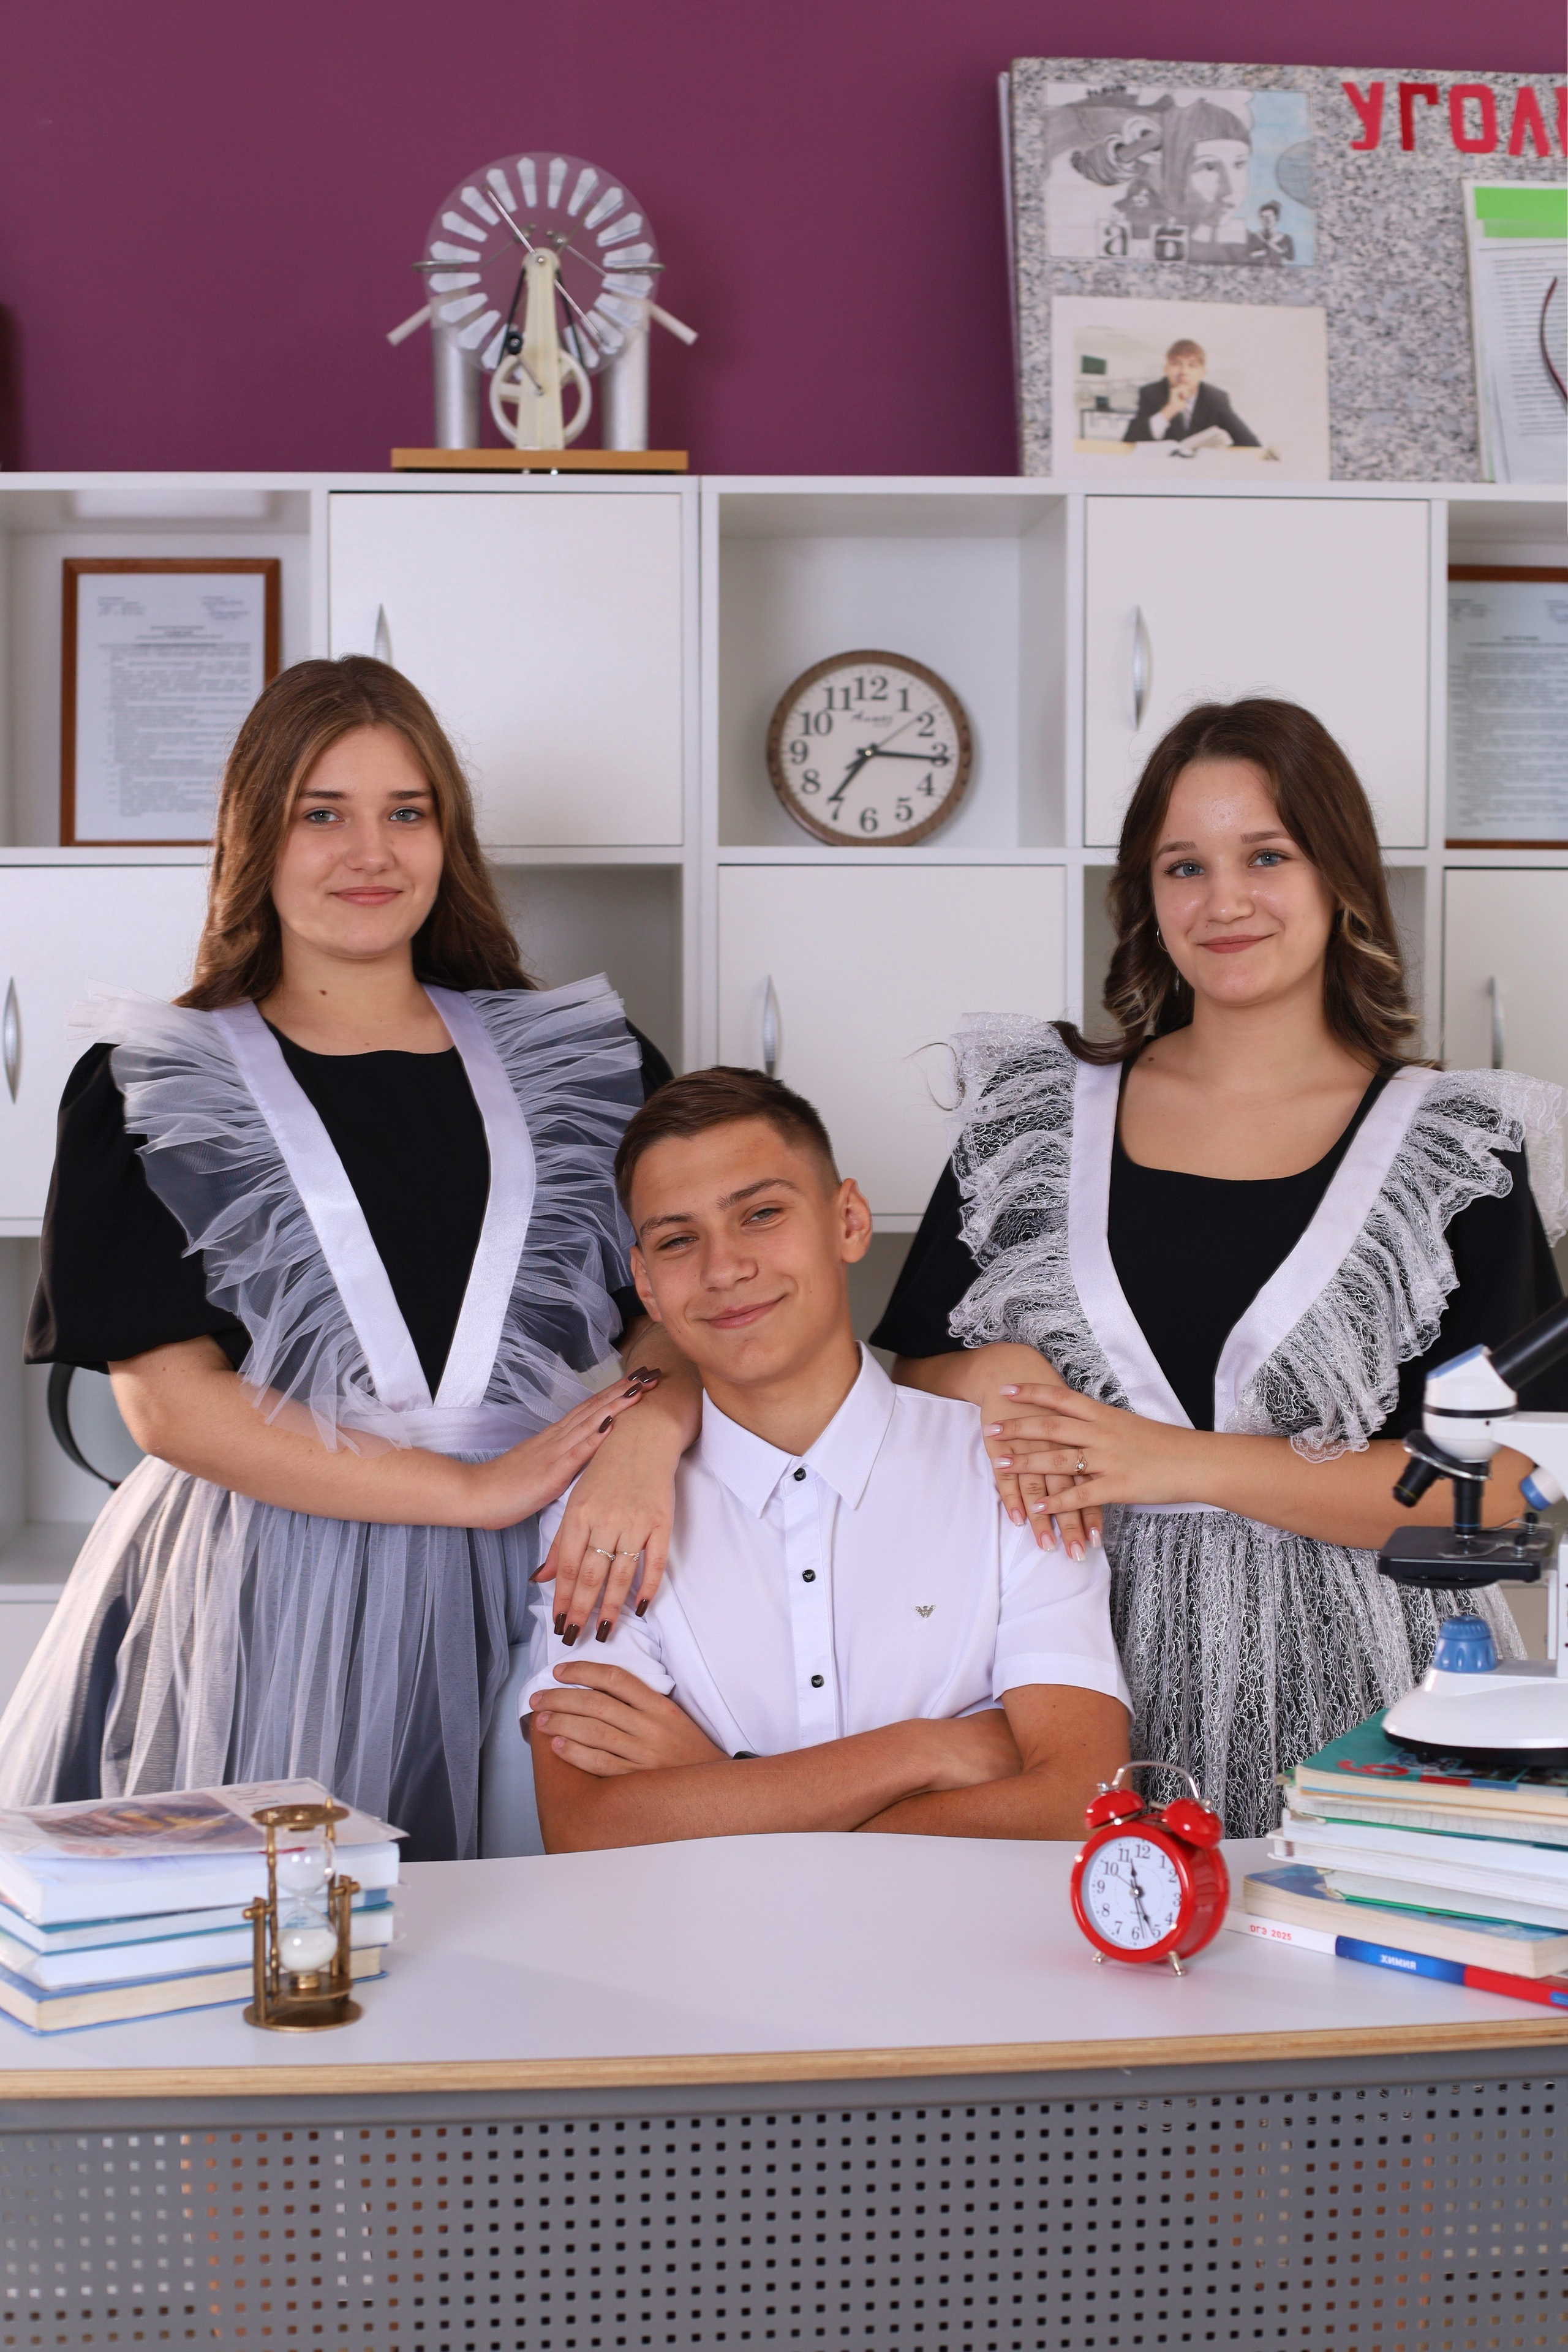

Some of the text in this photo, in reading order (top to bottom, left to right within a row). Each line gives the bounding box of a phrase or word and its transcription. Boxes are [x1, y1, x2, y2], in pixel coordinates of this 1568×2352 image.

[1341, 81, 1567, 157] УГОЛ
[854, 675, 888, 701] 12
[825, 686, 854, 710] 11
[897, 688, 911, 712] 1
[801, 711, 834, 736] 10
[917, 711, 935, 737] 2
[790, 740, 809, 764] 9
[930, 742, 950, 767] 3
[801, 769, 821, 794] 8
[916, 773, 935, 796] 4
[828, 796, 844, 821] 7
[895, 797, 913, 821] 5
[859, 808, 878, 833] 6
[1117, 1847, 1130, 1863] 11
[1134, 1844, 1150, 1858] 12
[1102, 1861, 1119, 1876] 10
[1159, 1855, 1166, 1869] 1
[1168, 1869, 1178, 1883] 2
[1096, 1880, 1106, 1894] 9
[1172, 1893, 1182, 1907] 3
[1101, 1902, 1110, 1917] 8
[1115, 1920, 1123, 1934] 7
[1165, 1912, 1174, 1926] 4
[1131, 1926, 1140, 1940] 6
[1152, 1924, 1162, 1938] 5
[1250, 1924, 1292, 1941] ОГЭ 2025
[1380, 1954, 1417, 1970] ХИМИЯ
